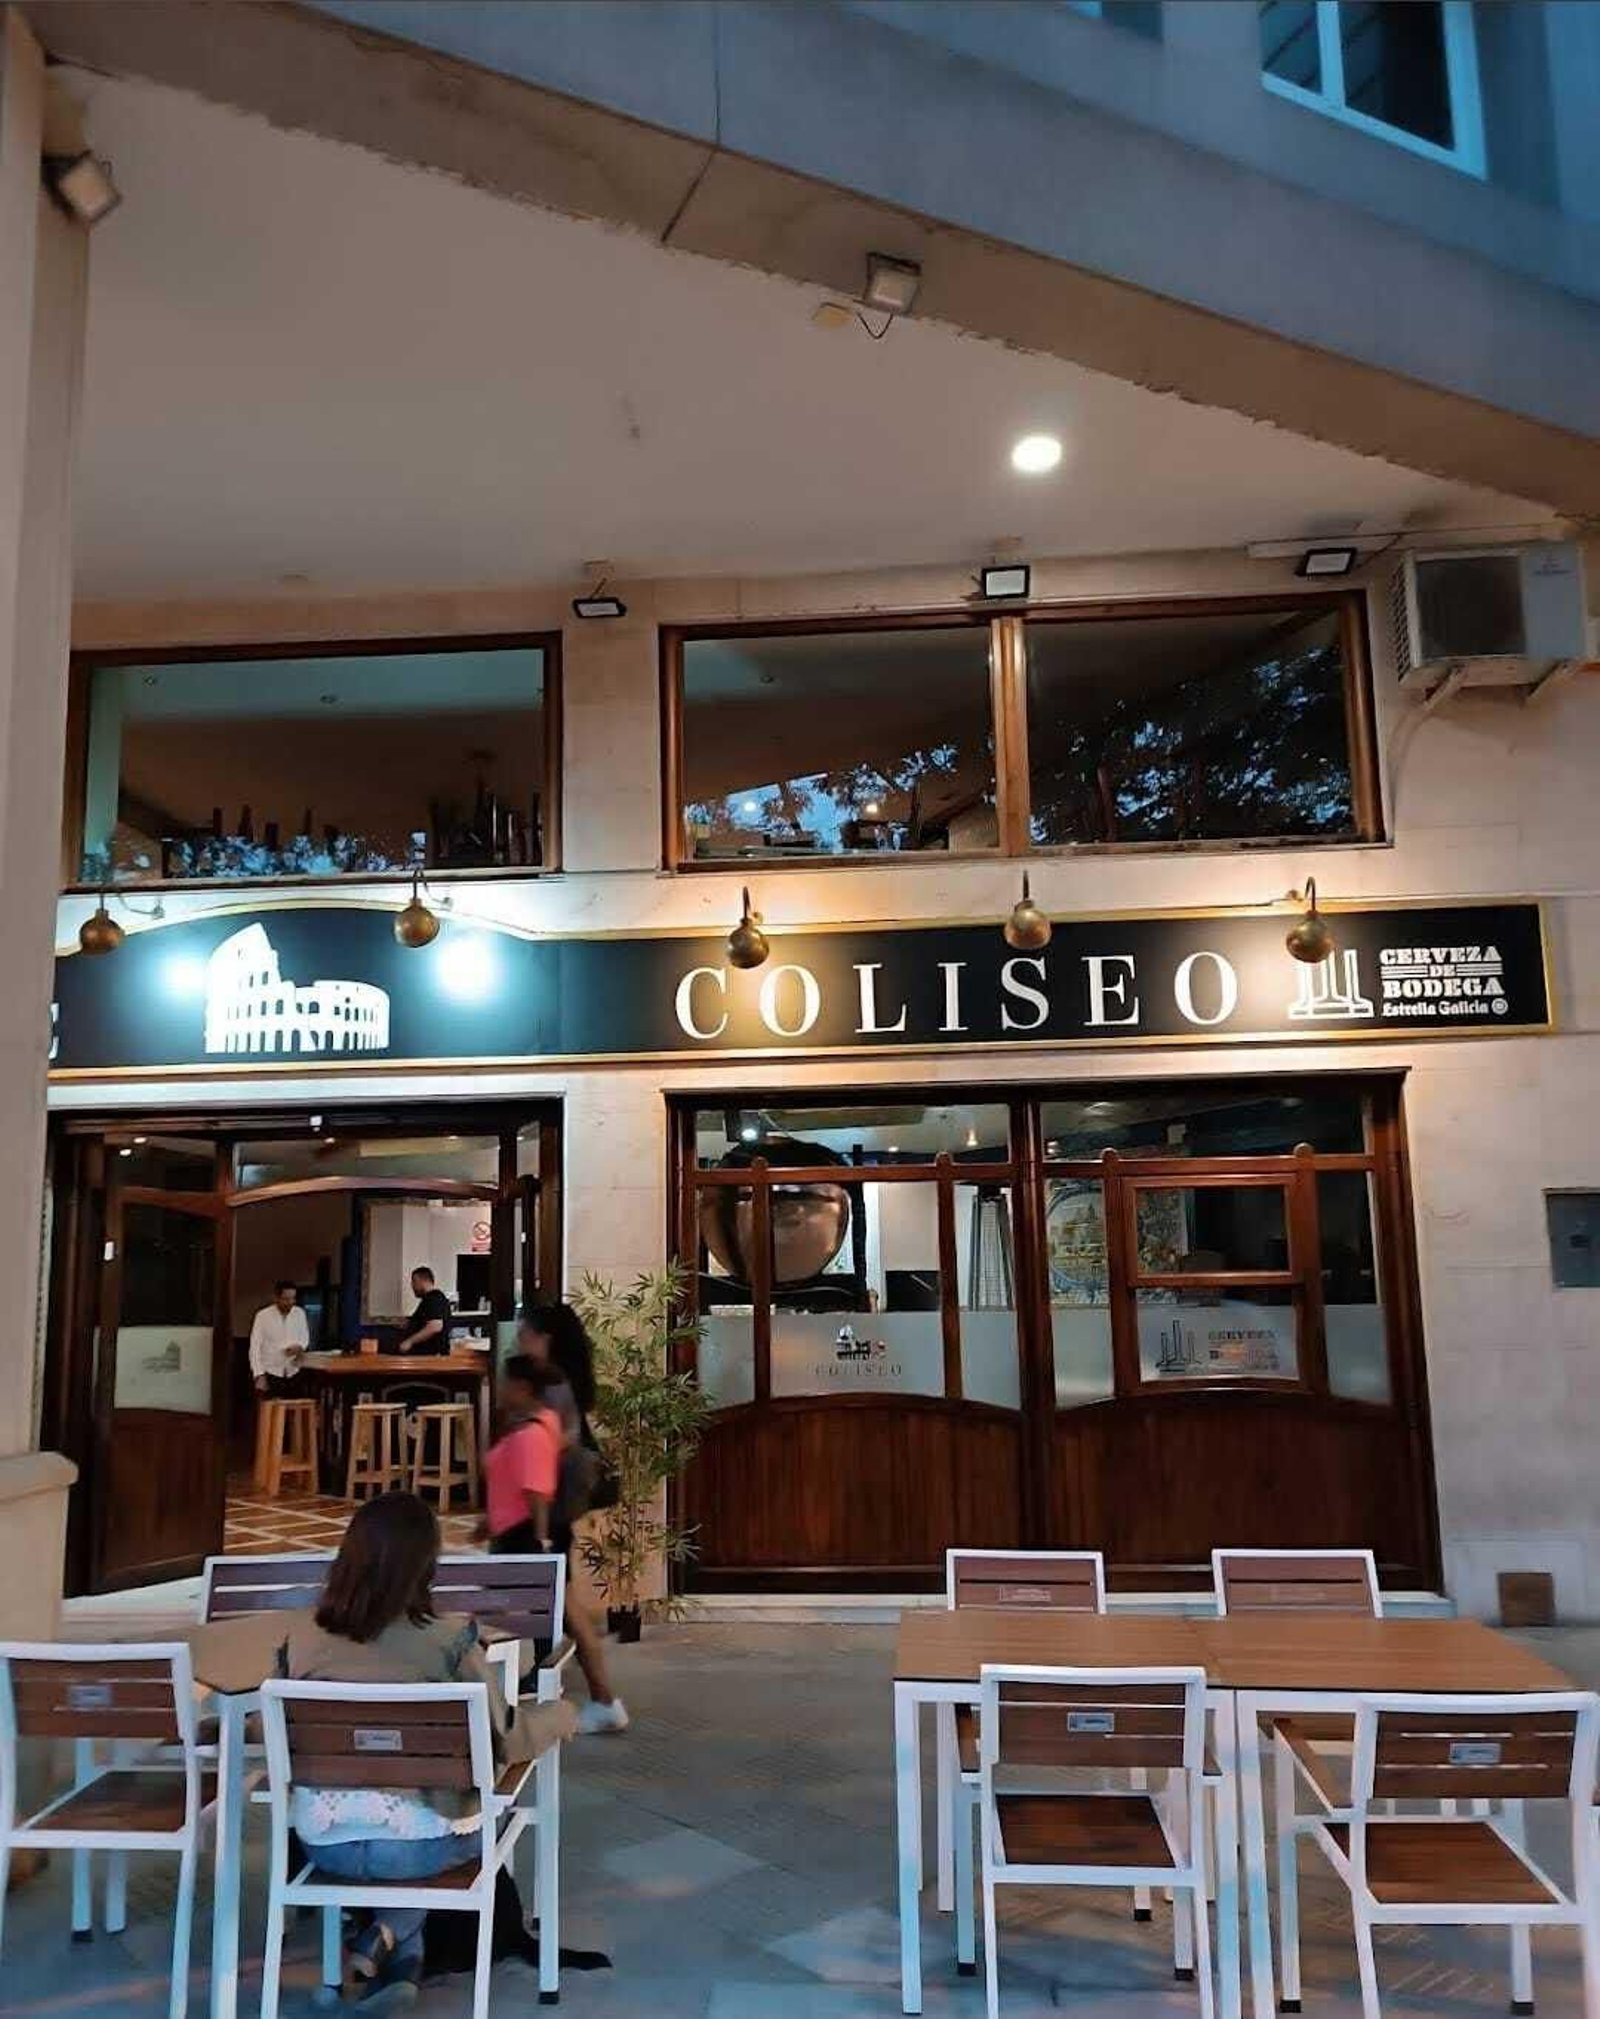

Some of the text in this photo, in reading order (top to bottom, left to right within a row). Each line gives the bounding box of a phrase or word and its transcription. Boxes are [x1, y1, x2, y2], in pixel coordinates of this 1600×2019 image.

[1380, 946, 1502, 965] CERVEZA
[1429, 964, 1456, 977] DE
[674, 951, 1239, 1039] COLISEO
[1382, 977, 1505, 998] BODEGA
[1382, 1000, 1489, 1017] Estrella Galicia
